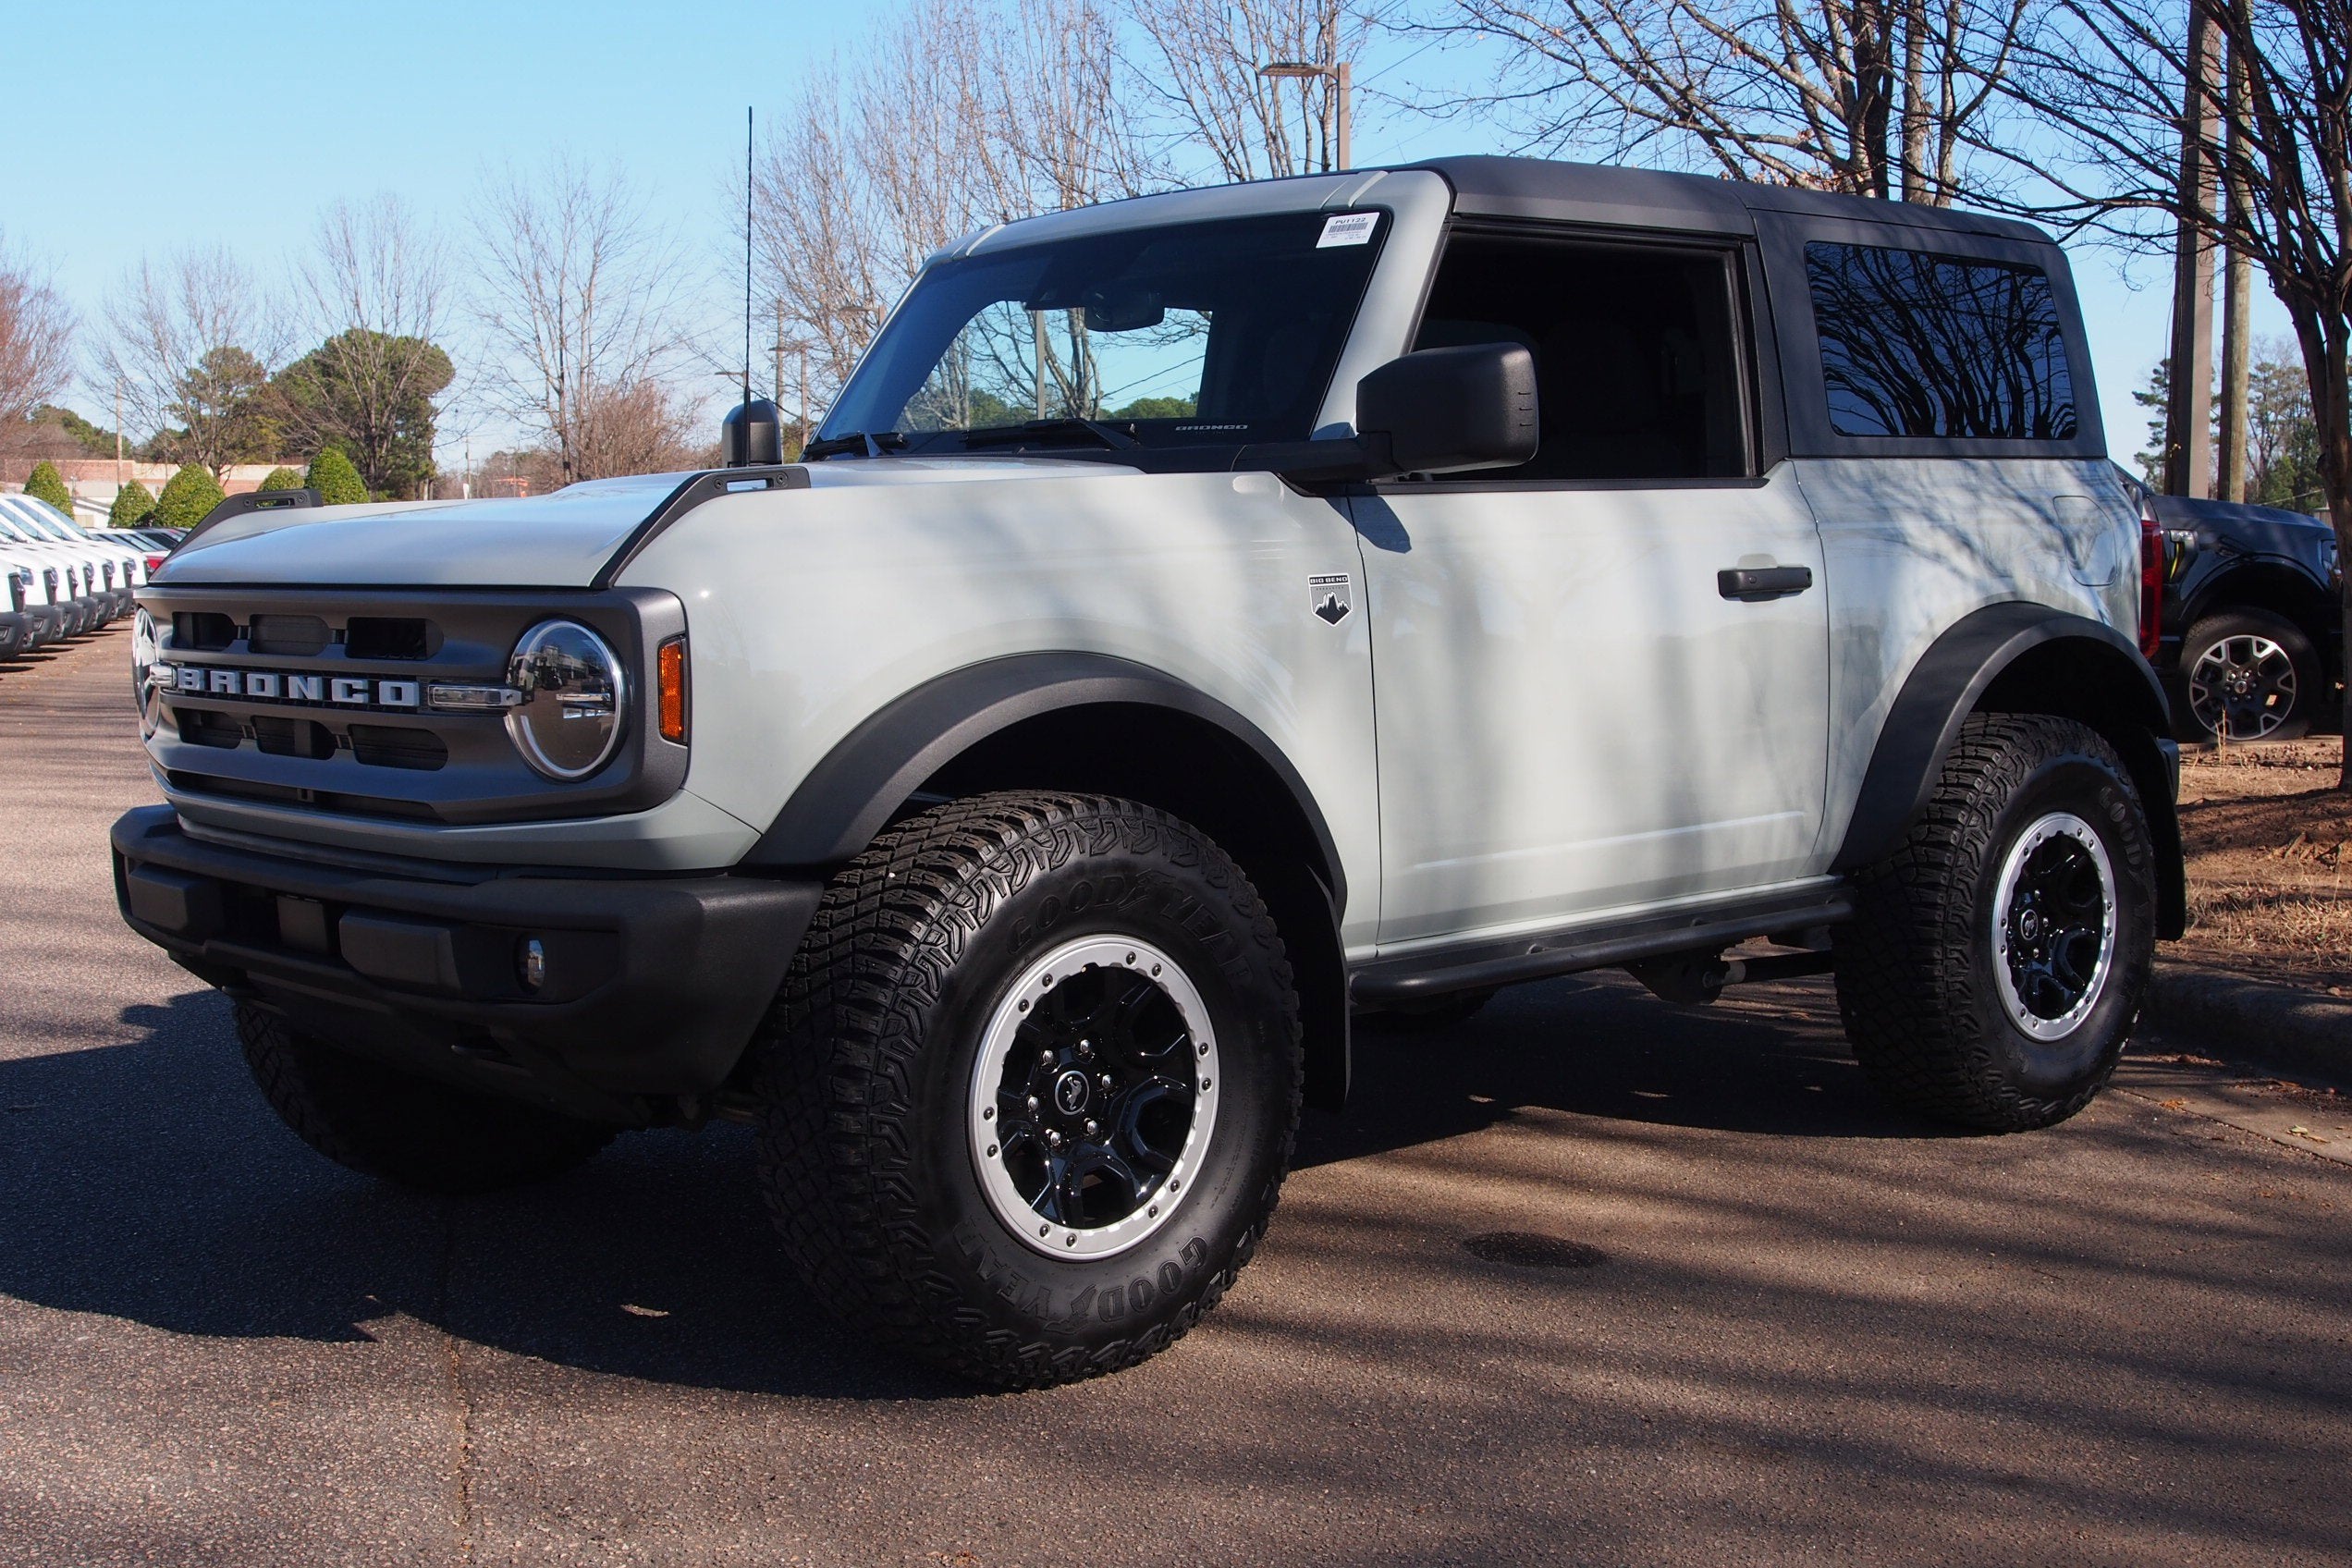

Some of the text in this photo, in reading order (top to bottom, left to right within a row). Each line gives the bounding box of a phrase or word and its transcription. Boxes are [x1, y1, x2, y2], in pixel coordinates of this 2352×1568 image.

[178, 667, 421, 707] BRONCO
[1007, 870, 1255, 992] GOODYEAR
[952, 1216, 1207, 1328] GOODYEAR
